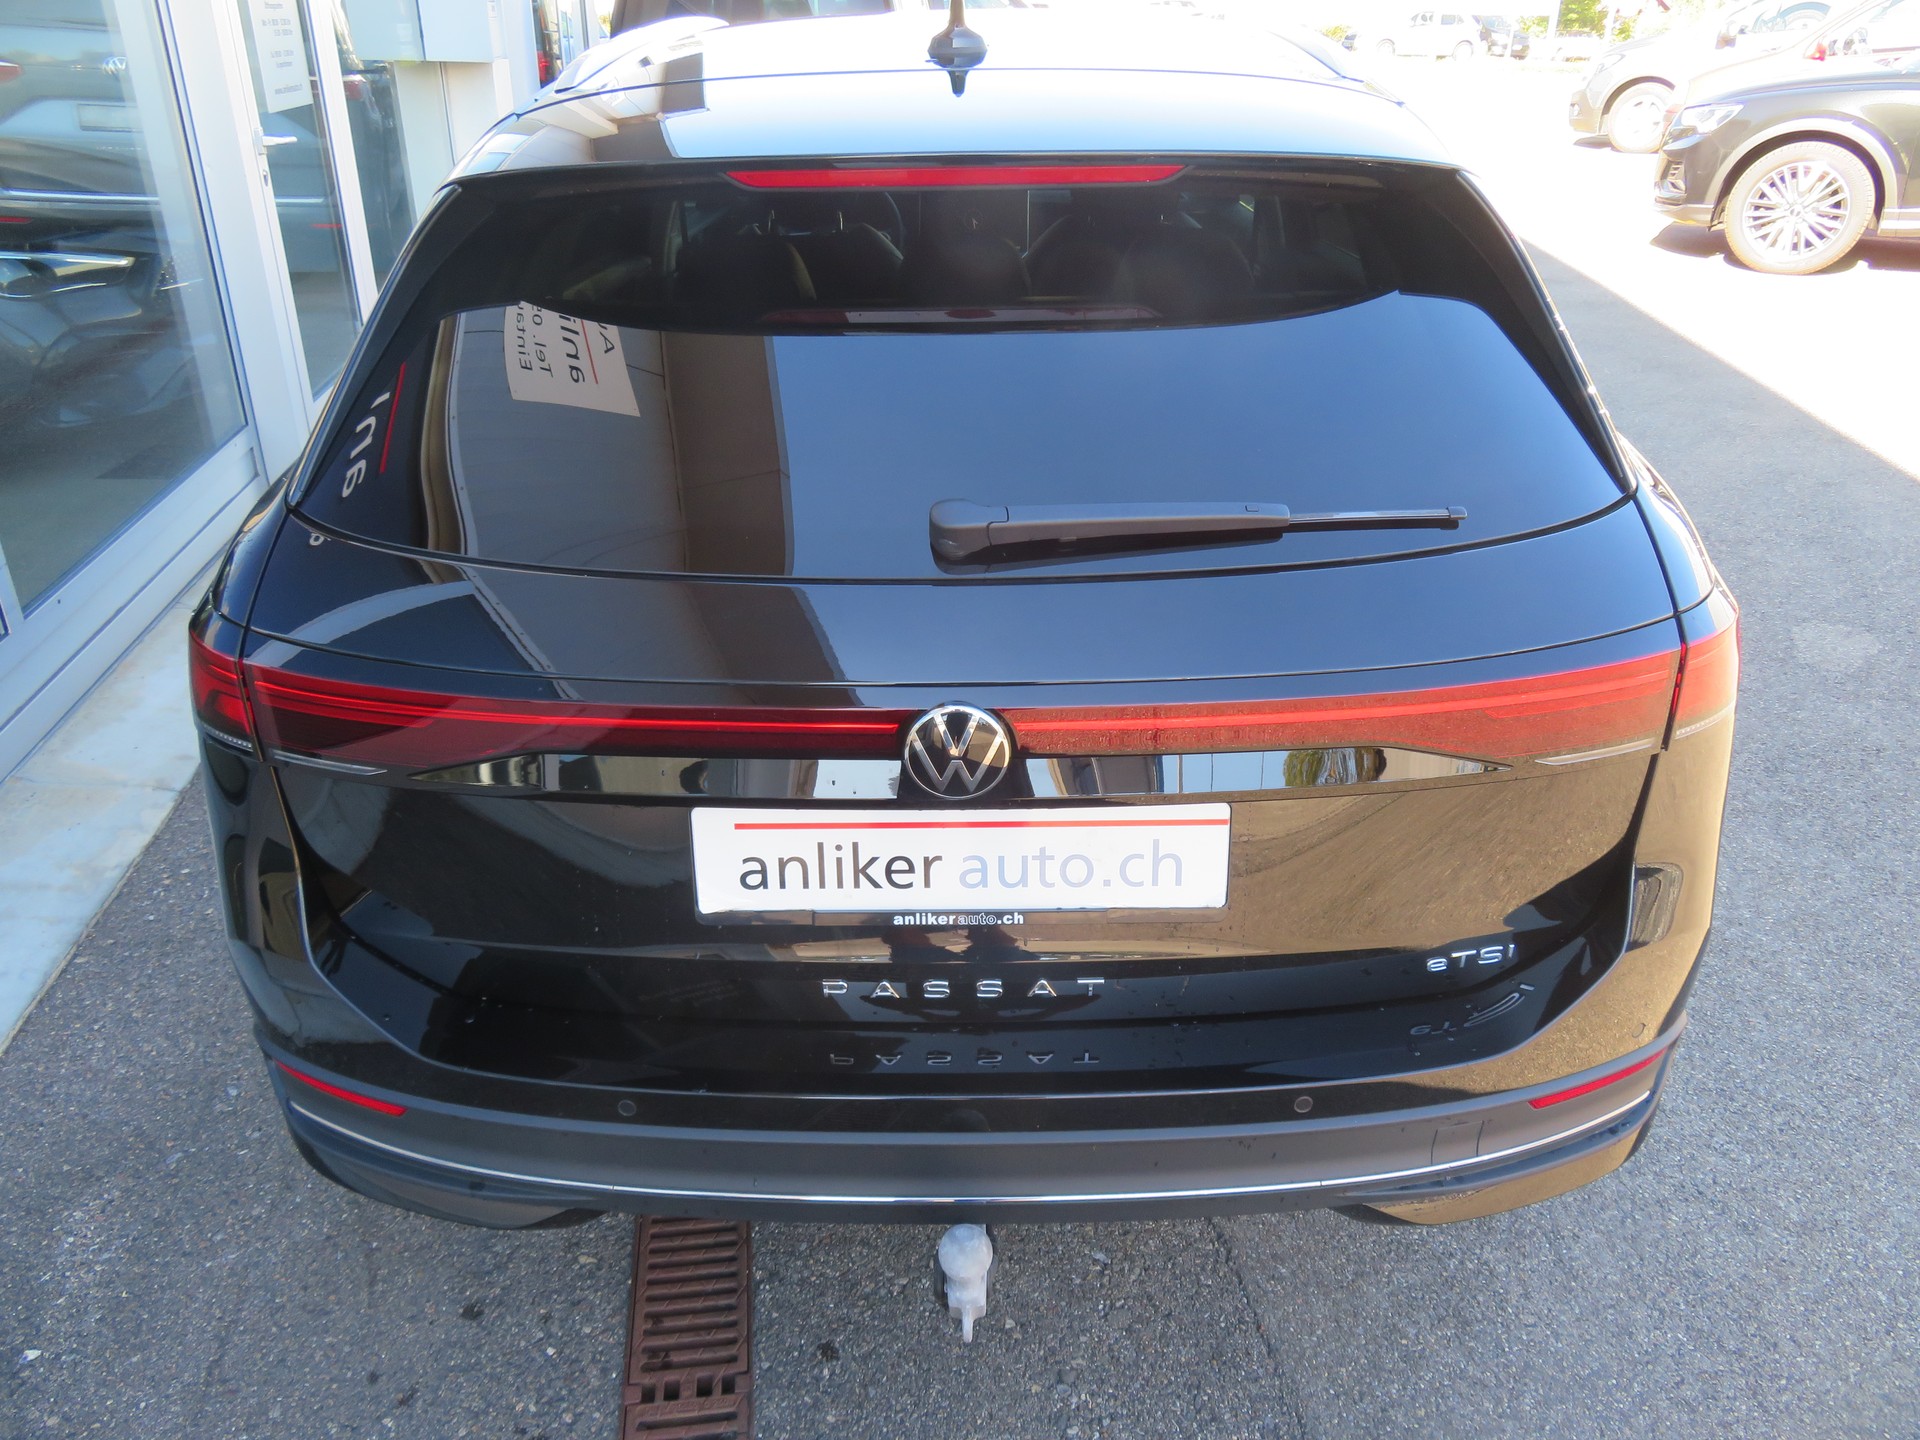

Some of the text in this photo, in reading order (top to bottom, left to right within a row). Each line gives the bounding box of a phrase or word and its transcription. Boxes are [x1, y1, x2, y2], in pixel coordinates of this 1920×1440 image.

[738, 838, 1184, 891] anliker auto.ch
[822, 977, 1105, 999] PASSAT
